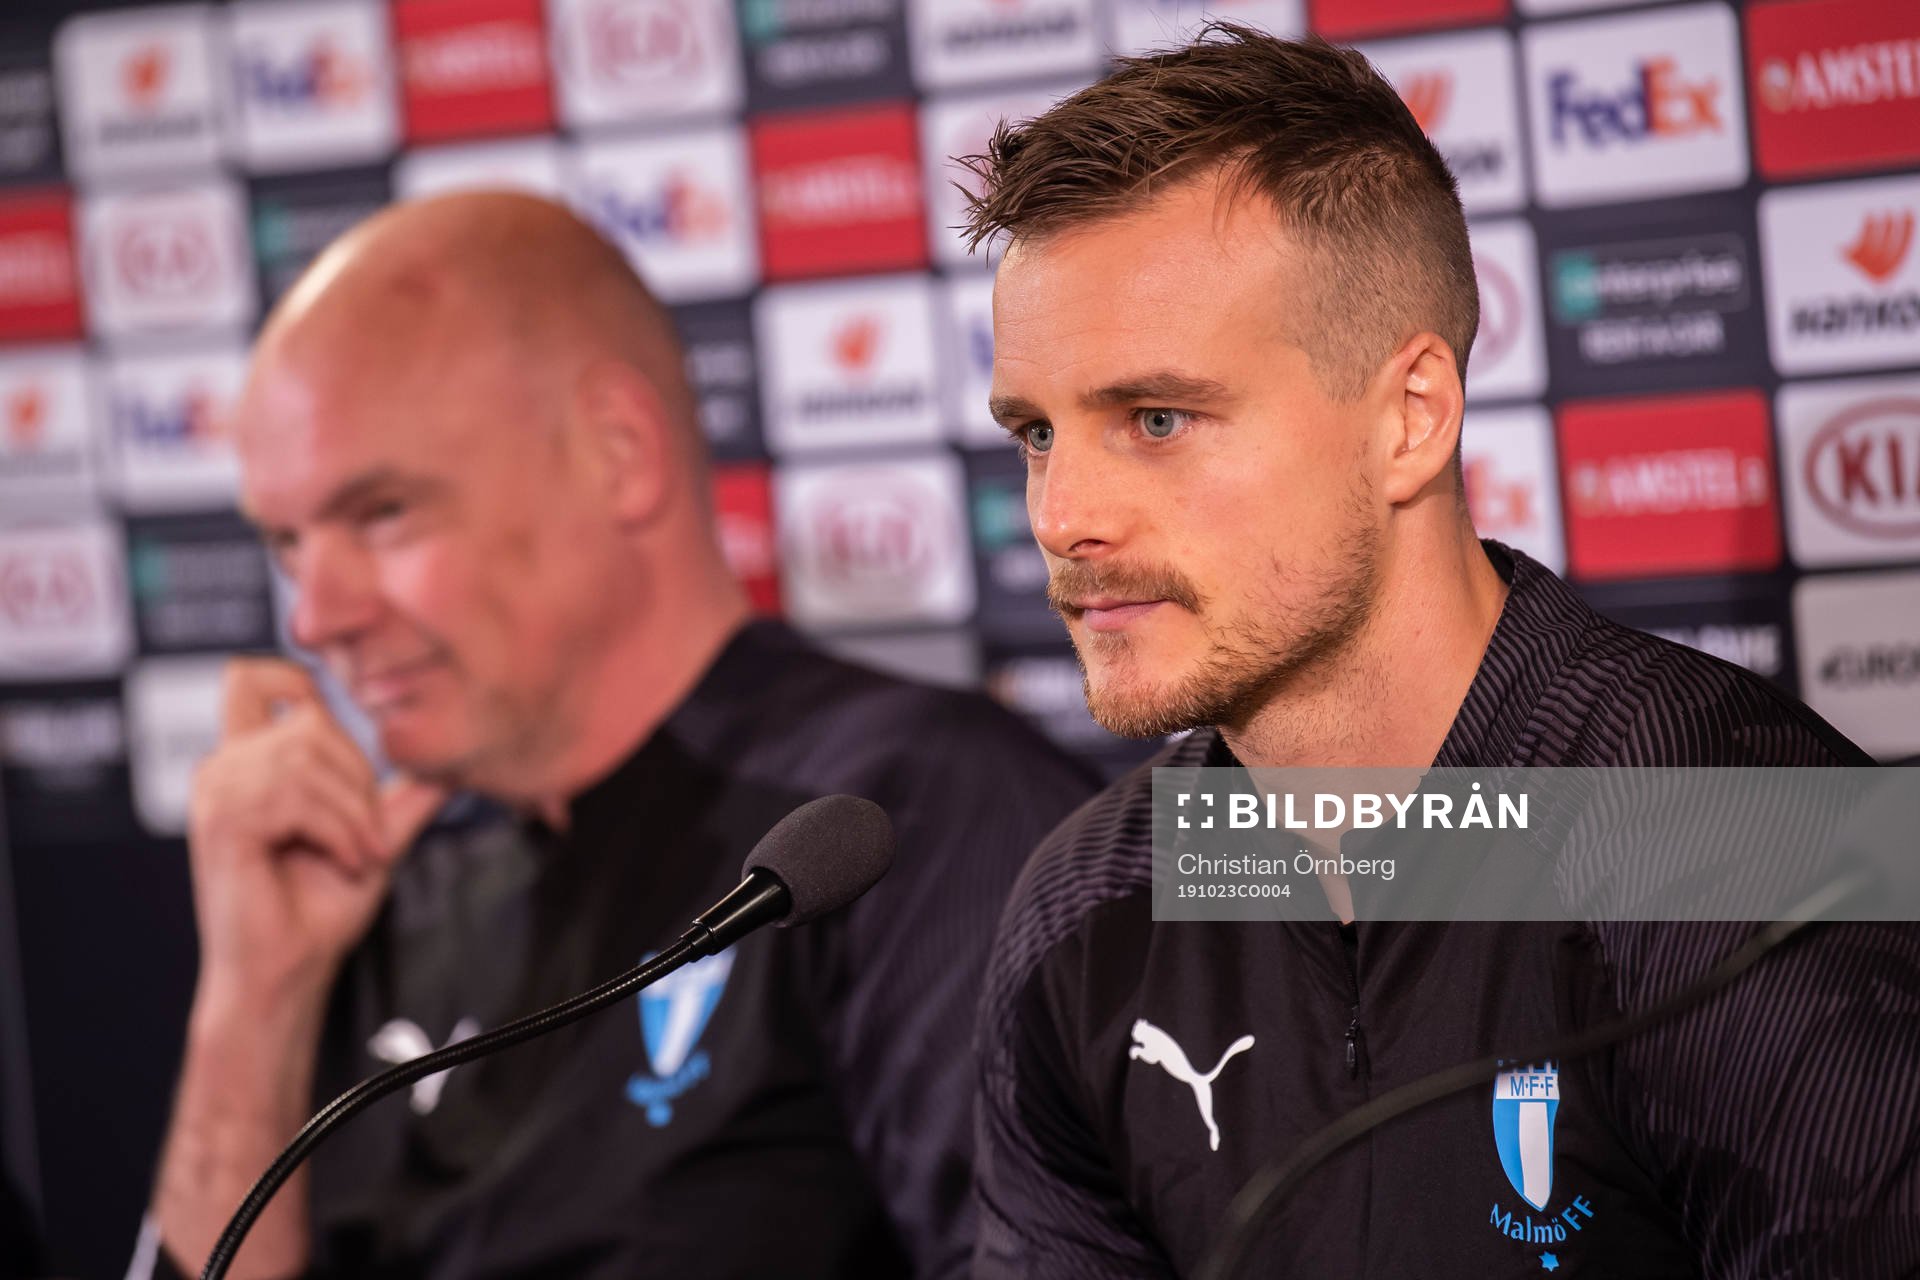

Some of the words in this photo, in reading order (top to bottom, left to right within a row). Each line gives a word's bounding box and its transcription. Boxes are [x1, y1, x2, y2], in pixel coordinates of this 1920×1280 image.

[1549, 57, 1722, 151] FedEx
[1792, 40, 1920, 112] AMSTE
[1837, 430, 1920, 505] KI
[1489, 1203, 1567, 1243] Malmö
[1561, 1194, 1595, 1231] FF
